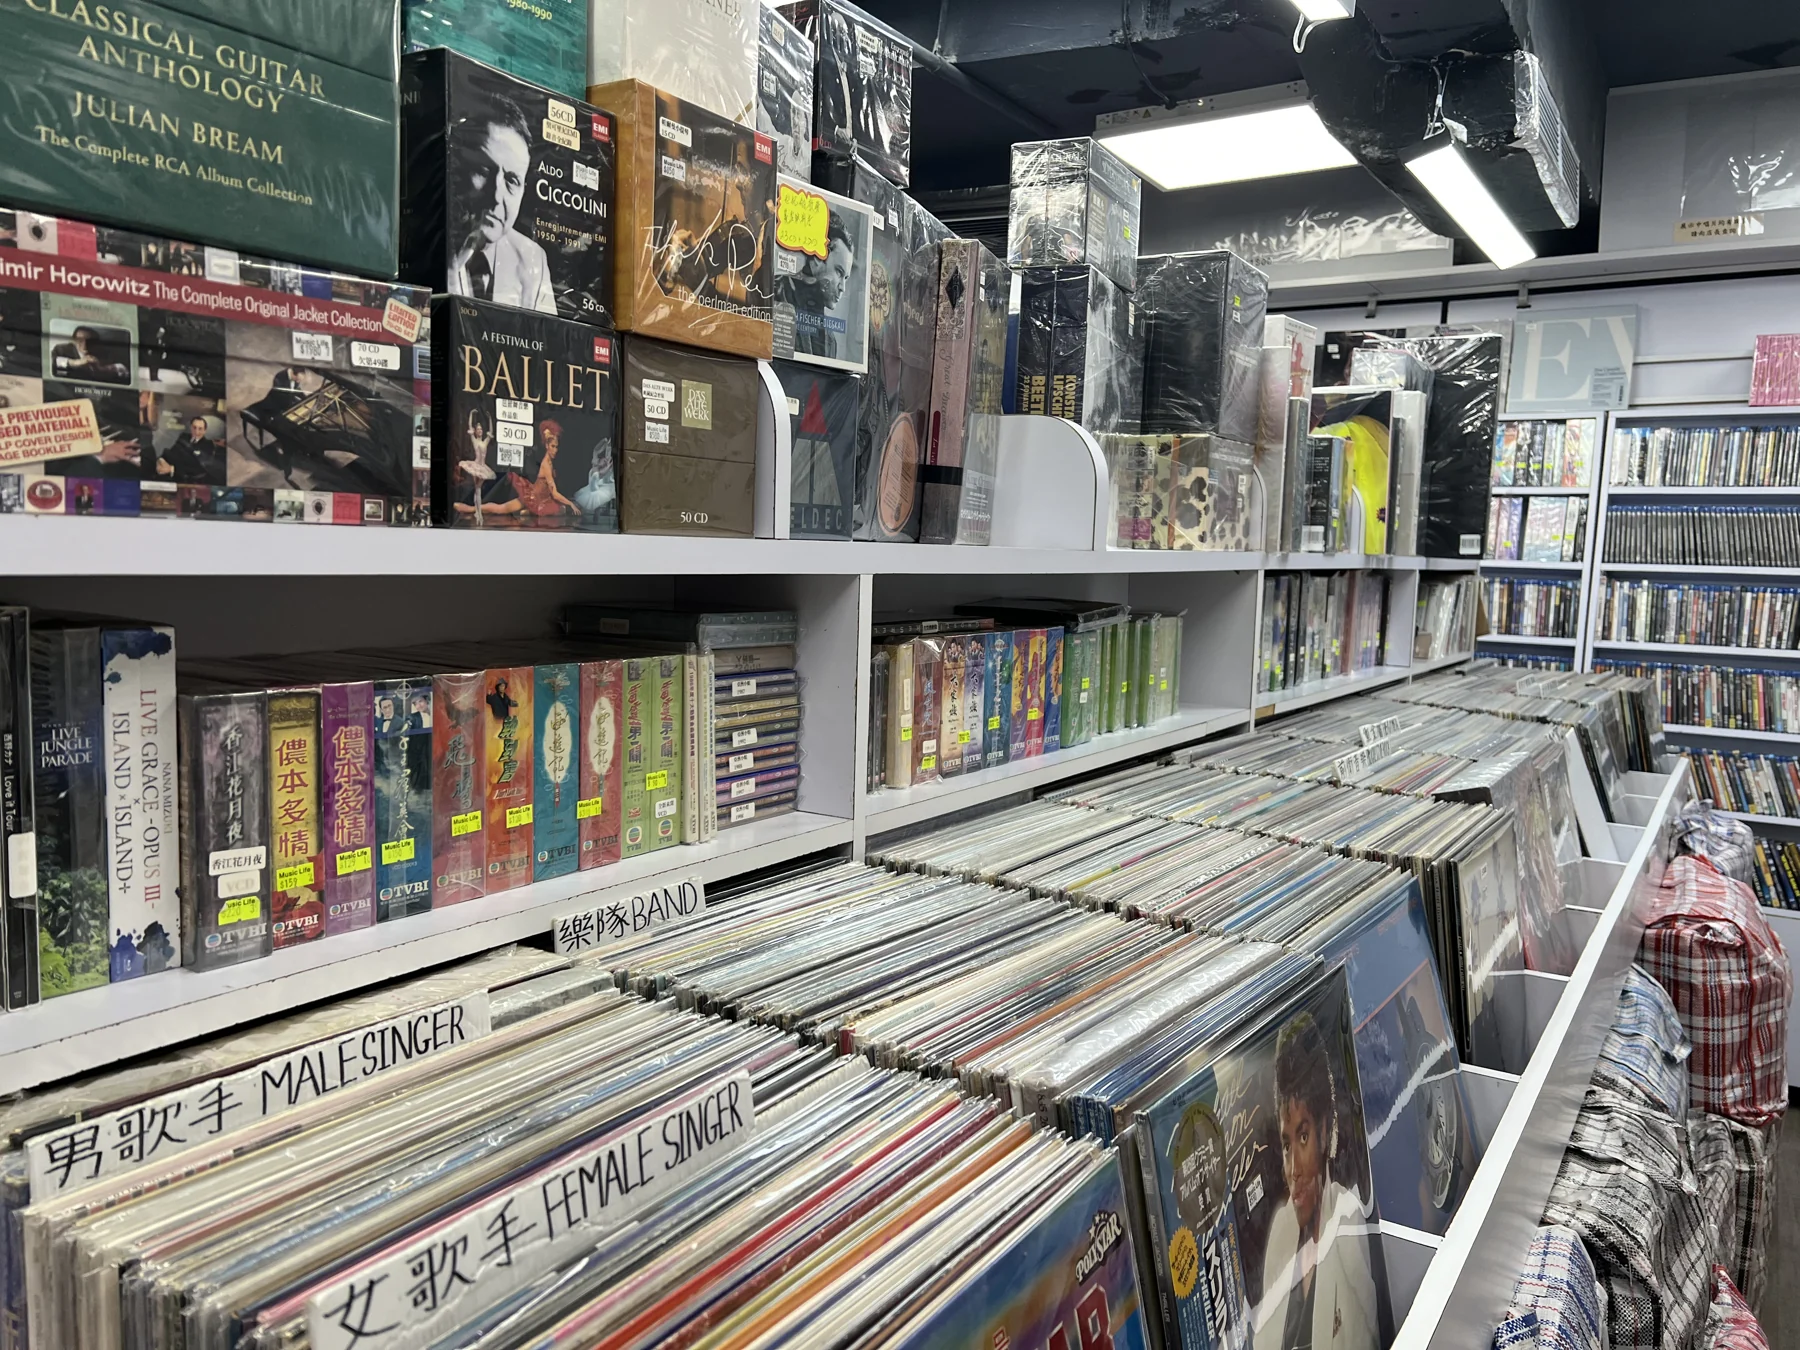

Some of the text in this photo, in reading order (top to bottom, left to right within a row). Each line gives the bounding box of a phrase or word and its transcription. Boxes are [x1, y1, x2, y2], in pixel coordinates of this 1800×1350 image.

[77, 35, 285, 114] ANTHOLOGY
[216, 45, 326, 98] GUITAR
[551, 106, 573, 124] 56CD
[72, 91, 284, 164] JULIAN BREAM
[593, 122, 608, 135] EMI
[755, 141, 772, 155] EMI
[34, 125, 314, 206] The Complete RCA Album Collection
[538, 160, 564, 178] ALDO
[663, 158, 685, 171] Music Life
[536, 179, 608, 219] CICCOLINI
[536, 217, 608, 244] Enregistrements EMI
[537, 229, 581, 248] 1950 1991
[49, 265, 151, 297] Horowitz
[153, 280, 179, 301] The
[181, 285, 242, 312] Complete
[244, 296, 290, 319] Original
[293, 305, 329, 326] Jacket
[330, 310, 383, 333] Collection
[582, 298, 605, 313] 56 CD
[678, 288, 771, 323] the perlman edition
[389, 302, 418, 323] LIMITED
[295, 337, 314, 347] Music
[358, 343, 380, 354] 70 CD
[481, 331, 544, 351] A FESTIVAL OF
[595, 346, 609, 356] EMI
[462, 344, 610, 412] BALLET
[688, 388, 706, 401] DAS
[1052, 374, 1065, 416] LIFSCHI
[647, 405, 667, 415] 50 CD
[684, 407, 710, 421] WERK
[685, 399, 708, 411] ALTE
[8, 405, 81, 424] PREVIOUSLY
[25, 417, 91, 434] MATERIAL!
[503, 427, 527, 440] 50 CD
[646, 425, 658, 433] Music
[15, 436, 52, 449] COVER
[54, 431, 94, 443] DESIGN
[22, 443, 72, 459] BOOKLET
[680, 511, 709, 524] 50 CD
[51, 726, 81, 740] LIVE
[41, 737, 93, 755] JUNGLE
[41, 751, 93, 768] PARADE
[3, 774, 13, 799] Love
[222, 724, 244, 844] 香江花月夜
[332, 725, 367, 848] 儂本多情
[112, 710, 133, 894] ISLAND ISLAND+
[140, 689, 160, 910] LIVE GRACE -OPUS III-
[162, 762, 174, 834] NANA MIZUKI
[275, 738, 309, 858] 儂本多情
[577, 799, 601, 810] Music Life
[452, 814, 480, 826] Music Life
[508, 805, 531, 818] Music Life
[5, 810, 15, 832] Tour
[384, 840, 411, 852] Music Life
[592, 834, 619, 850] TVBI
[626, 844, 642, 853] TVBI
[340, 849, 368, 861] Music Life
[547, 844, 577, 862] TVBI
[212, 854, 263, 871] 香江花月夜
[500, 855, 531, 875] TVBI
[278, 866, 311, 880] Music Life
[446, 867, 483, 883] TVBI
[227, 878, 255, 891] VCD
[280, 878, 299, 889] $159
[393, 879, 430, 898] TVBI
[226, 897, 256, 909] usic Life
[340, 897, 372, 913] TVBI
[283, 915, 319, 930] TVBI
[559, 881, 698, 953] 樂隊 BAND
[221, 922, 267, 941] TVBI
[44, 1004, 466, 1188] 男歌手 MALE SINGER
[323, 1080, 745, 1350] 女歌手 FEMALE SINGER
[1198, 1266, 1216, 1342] THRILLER
